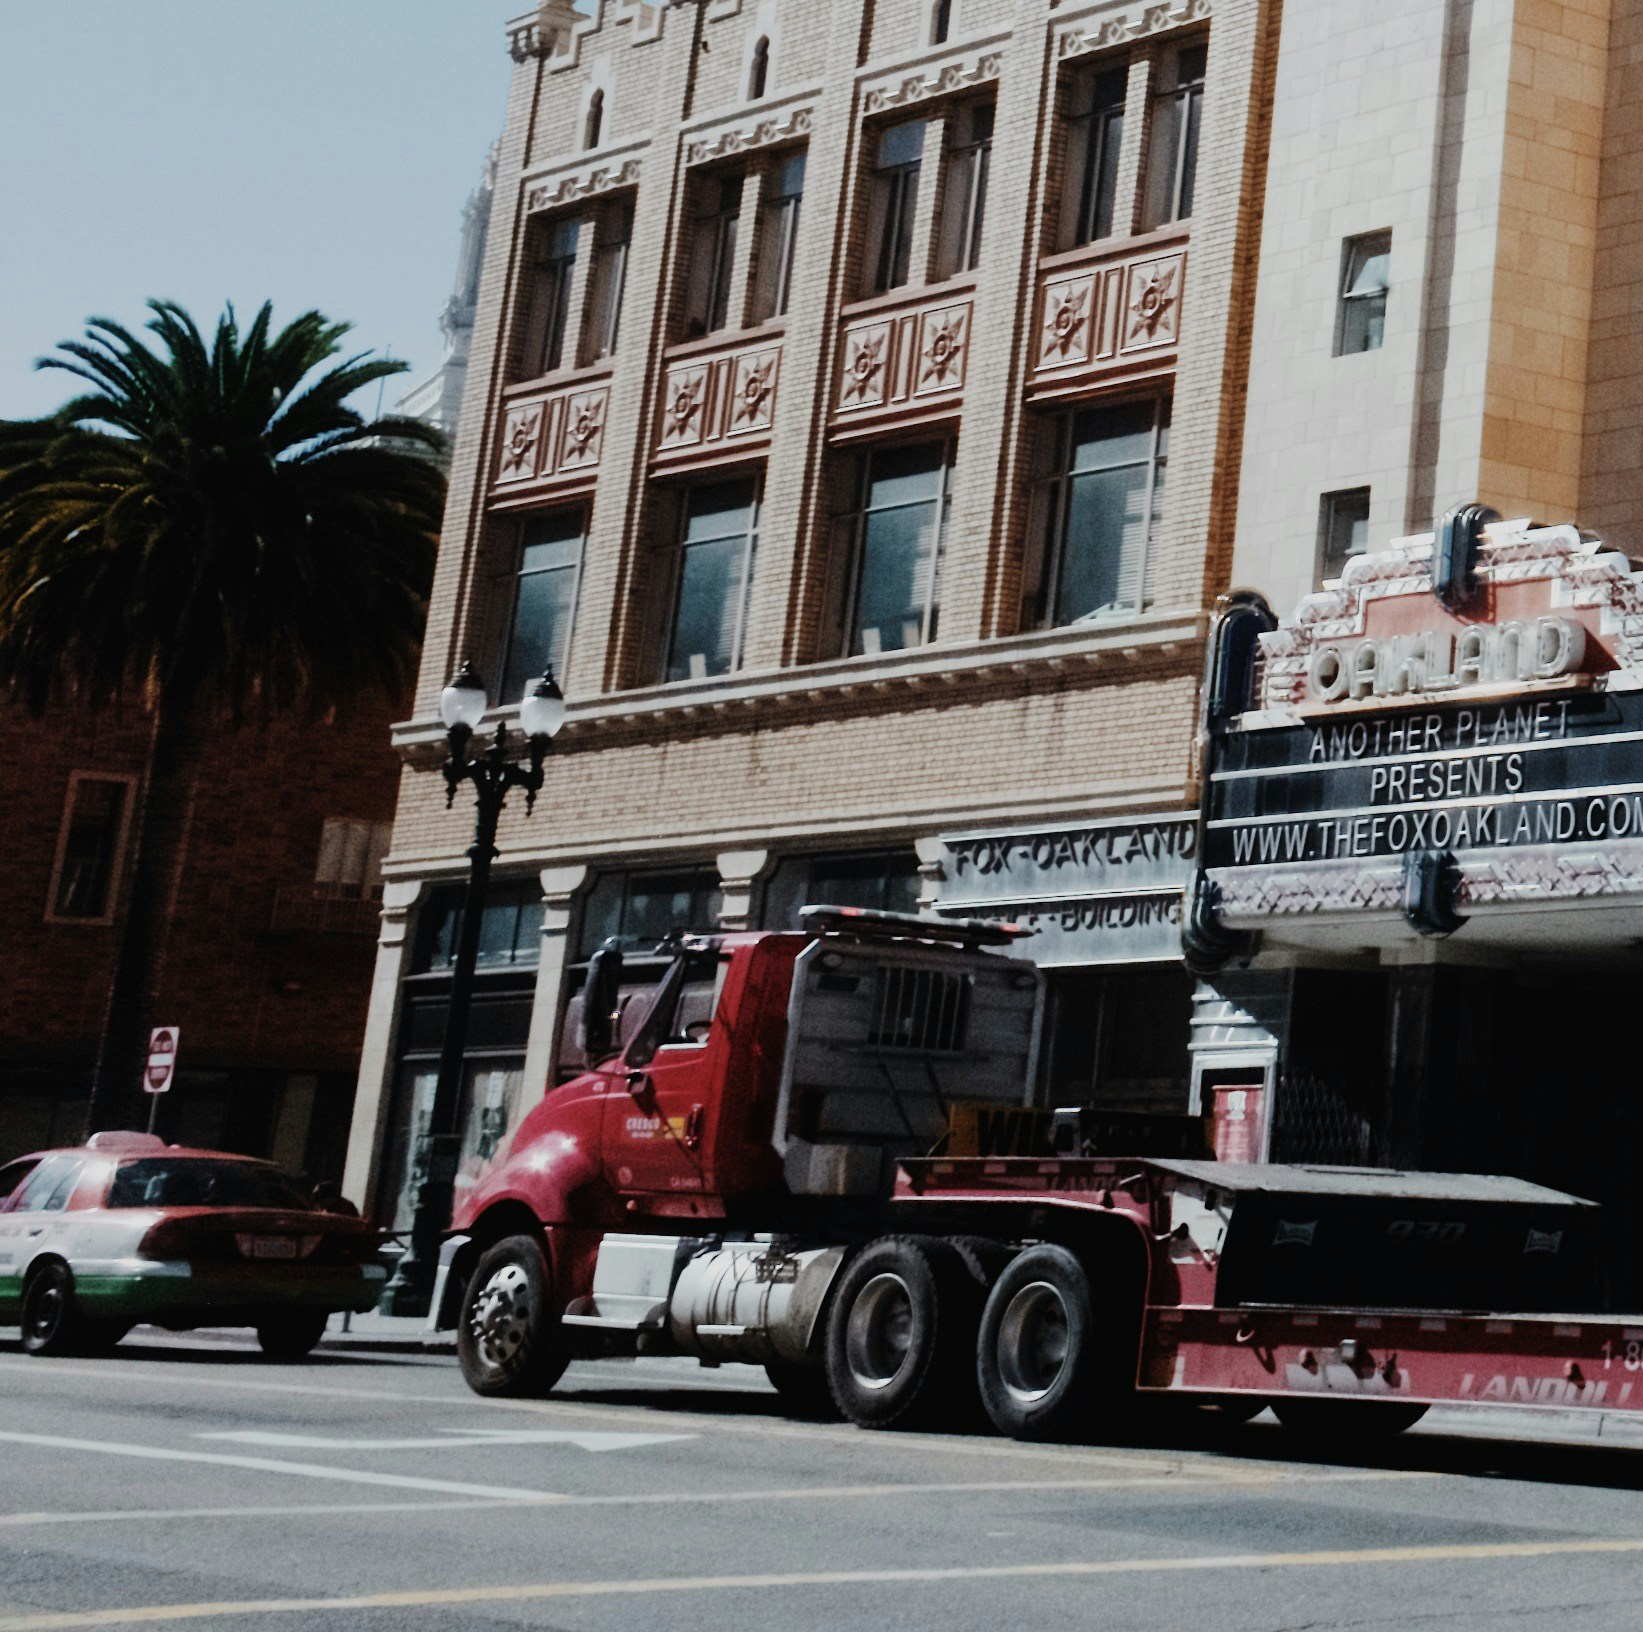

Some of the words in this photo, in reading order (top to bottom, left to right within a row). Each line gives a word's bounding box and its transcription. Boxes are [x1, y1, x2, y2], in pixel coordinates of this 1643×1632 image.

[1309, 615, 1581, 702] OAKLAND
[1309, 713, 1443, 763] ANOTHER
[1455, 699, 1573, 747] PLANET
[1369, 753, 1524, 805] PRESENTS
